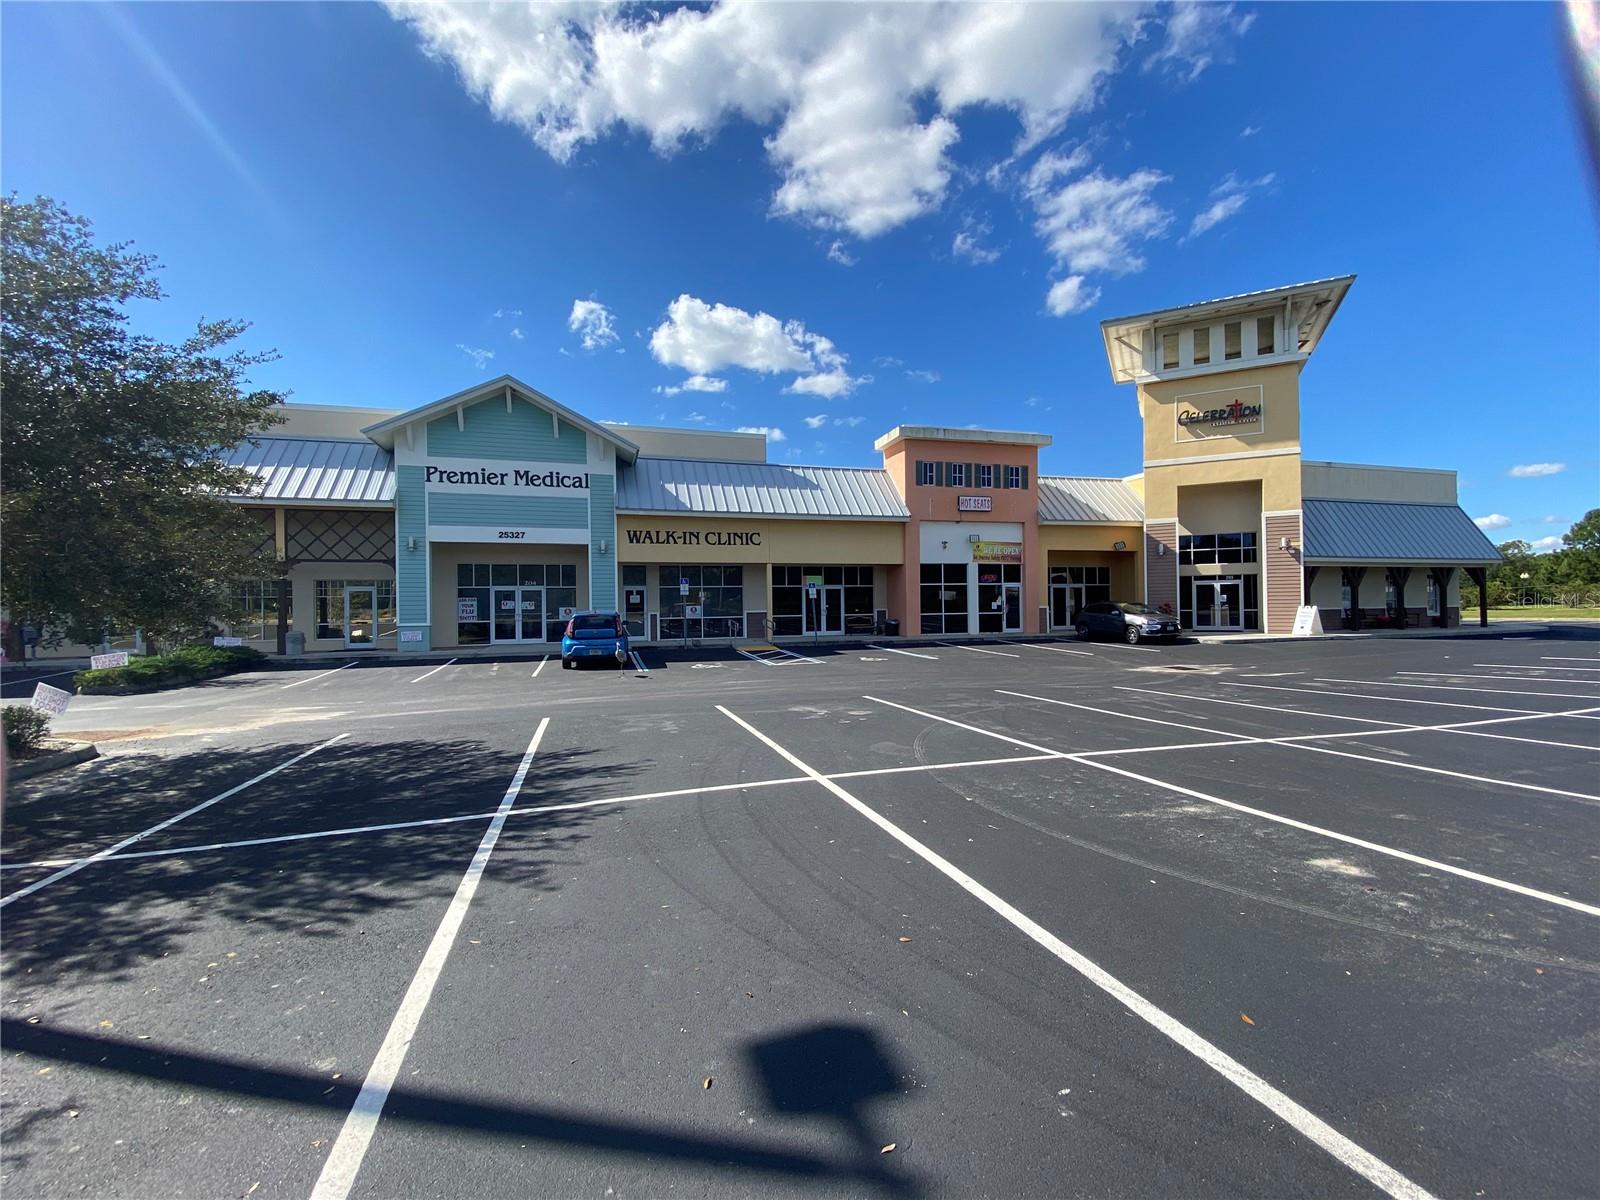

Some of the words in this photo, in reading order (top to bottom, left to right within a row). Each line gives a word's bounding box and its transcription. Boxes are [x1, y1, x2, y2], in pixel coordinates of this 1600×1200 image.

[425, 466, 508, 486] Premier
[514, 469, 590, 489] Medical
[960, 498, 972, 509] HOT
[973, 499, 990, 509] SEATS
[499, 531, 526, 539] 25327
[627, 530, 700, 544] WALK-IN
[705, 531, 761, 545] CLINIC
